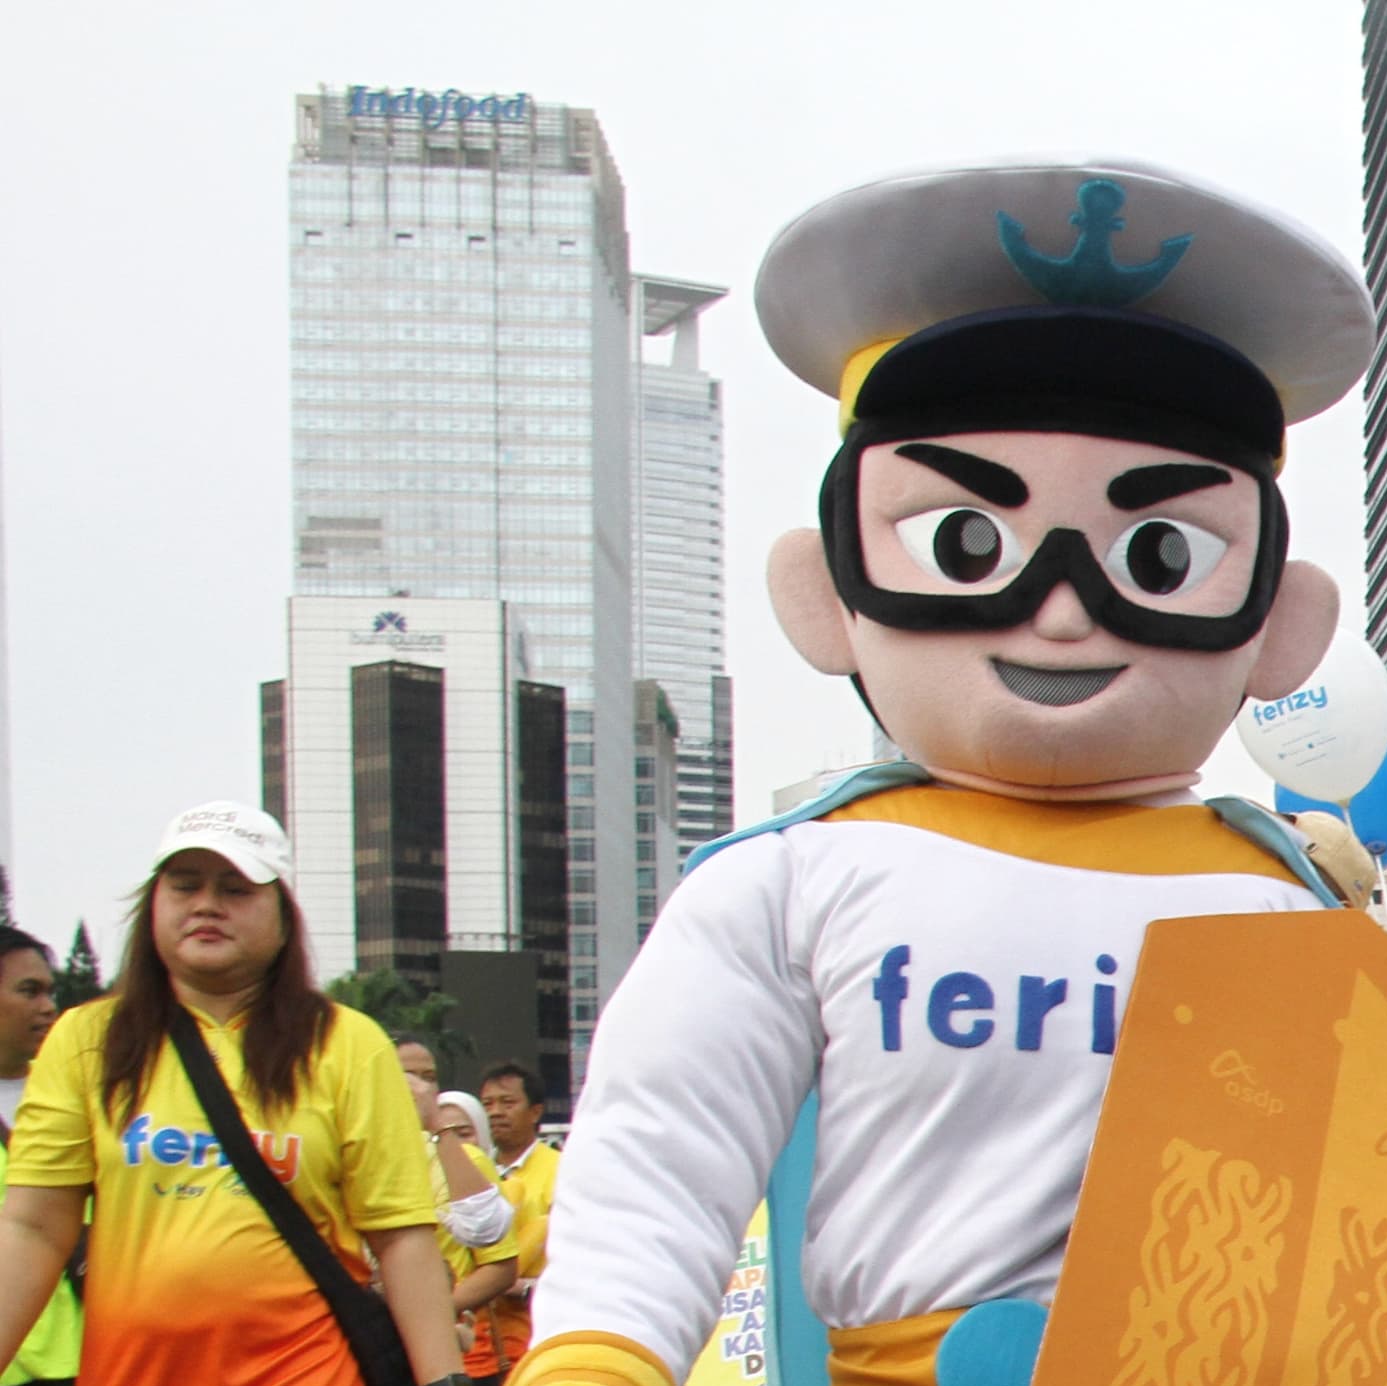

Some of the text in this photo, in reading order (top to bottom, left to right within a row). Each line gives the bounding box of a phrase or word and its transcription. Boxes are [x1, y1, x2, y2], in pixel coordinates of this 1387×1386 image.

[348, 86, 529, 130] Indofood
[1225, 1081, 1284, 1117] asdp
[122, 1113, 300, 1184] fery
